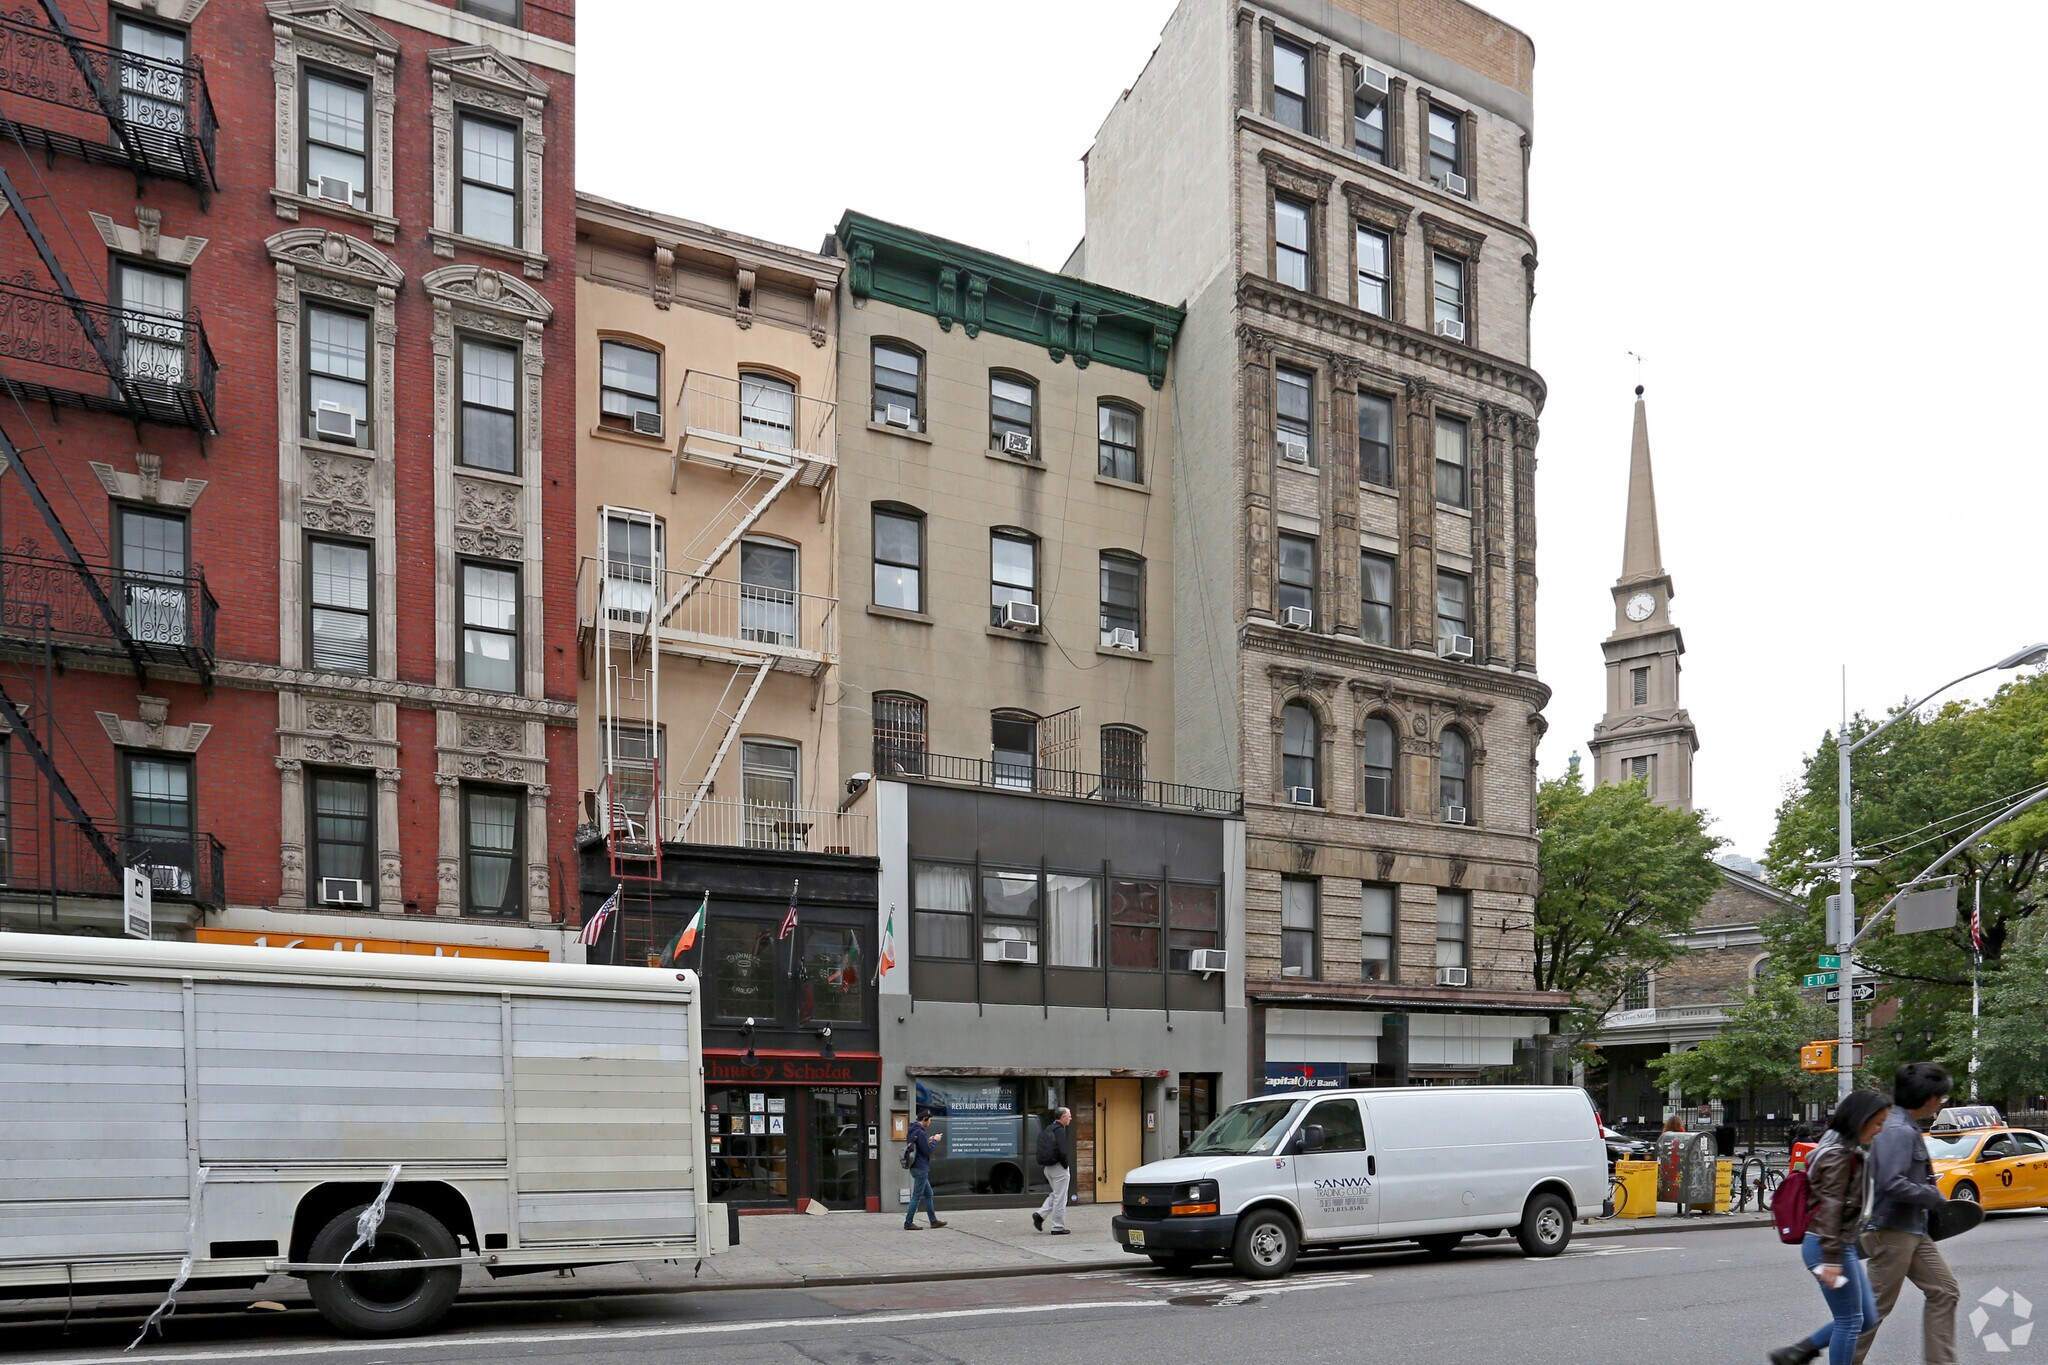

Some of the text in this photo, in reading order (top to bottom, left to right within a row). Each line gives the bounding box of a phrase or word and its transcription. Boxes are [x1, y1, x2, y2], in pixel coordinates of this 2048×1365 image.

[1825, 957, 1830, 967] 2
[1808, 976, 1813, 986] E
[1816, 975, 1826, 985] 10
[1854, 988, 1868, 996] WAY
[1317, 1079, 1339, 1087] Bank
[772, 1119, 781, 1128] A
[1958, 1114, 1997, 1127] MILLY
[1280, 1158, 1286, 1167] 5
[1314, 1177, 1371, 1190] SANWA
[1316, 1188, 1345, 1198] TRADING
